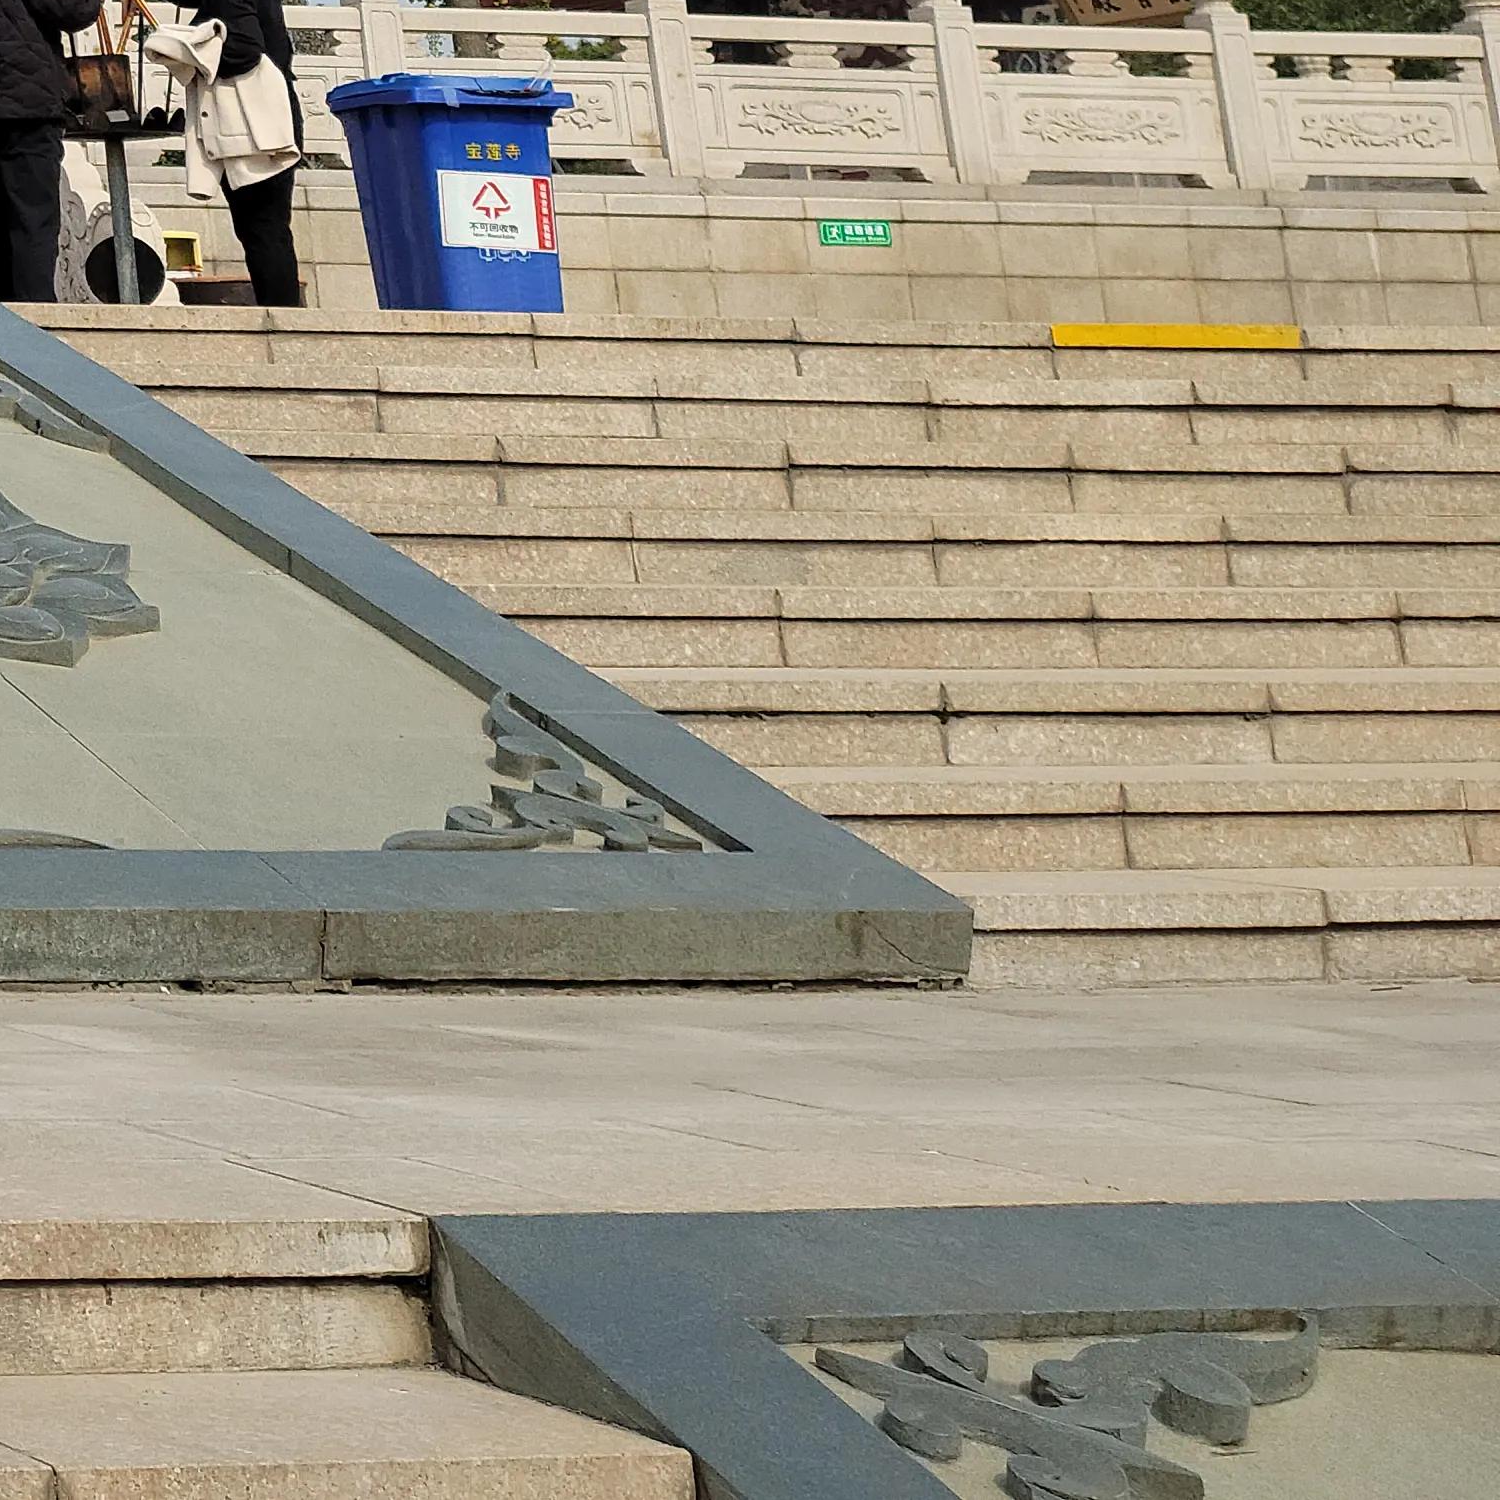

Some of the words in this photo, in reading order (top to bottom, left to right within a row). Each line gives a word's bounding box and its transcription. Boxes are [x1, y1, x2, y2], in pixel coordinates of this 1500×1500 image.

[465, 142, 521, 160] 宝莲寺
[468, 221, 519, 234] 不可回收物
